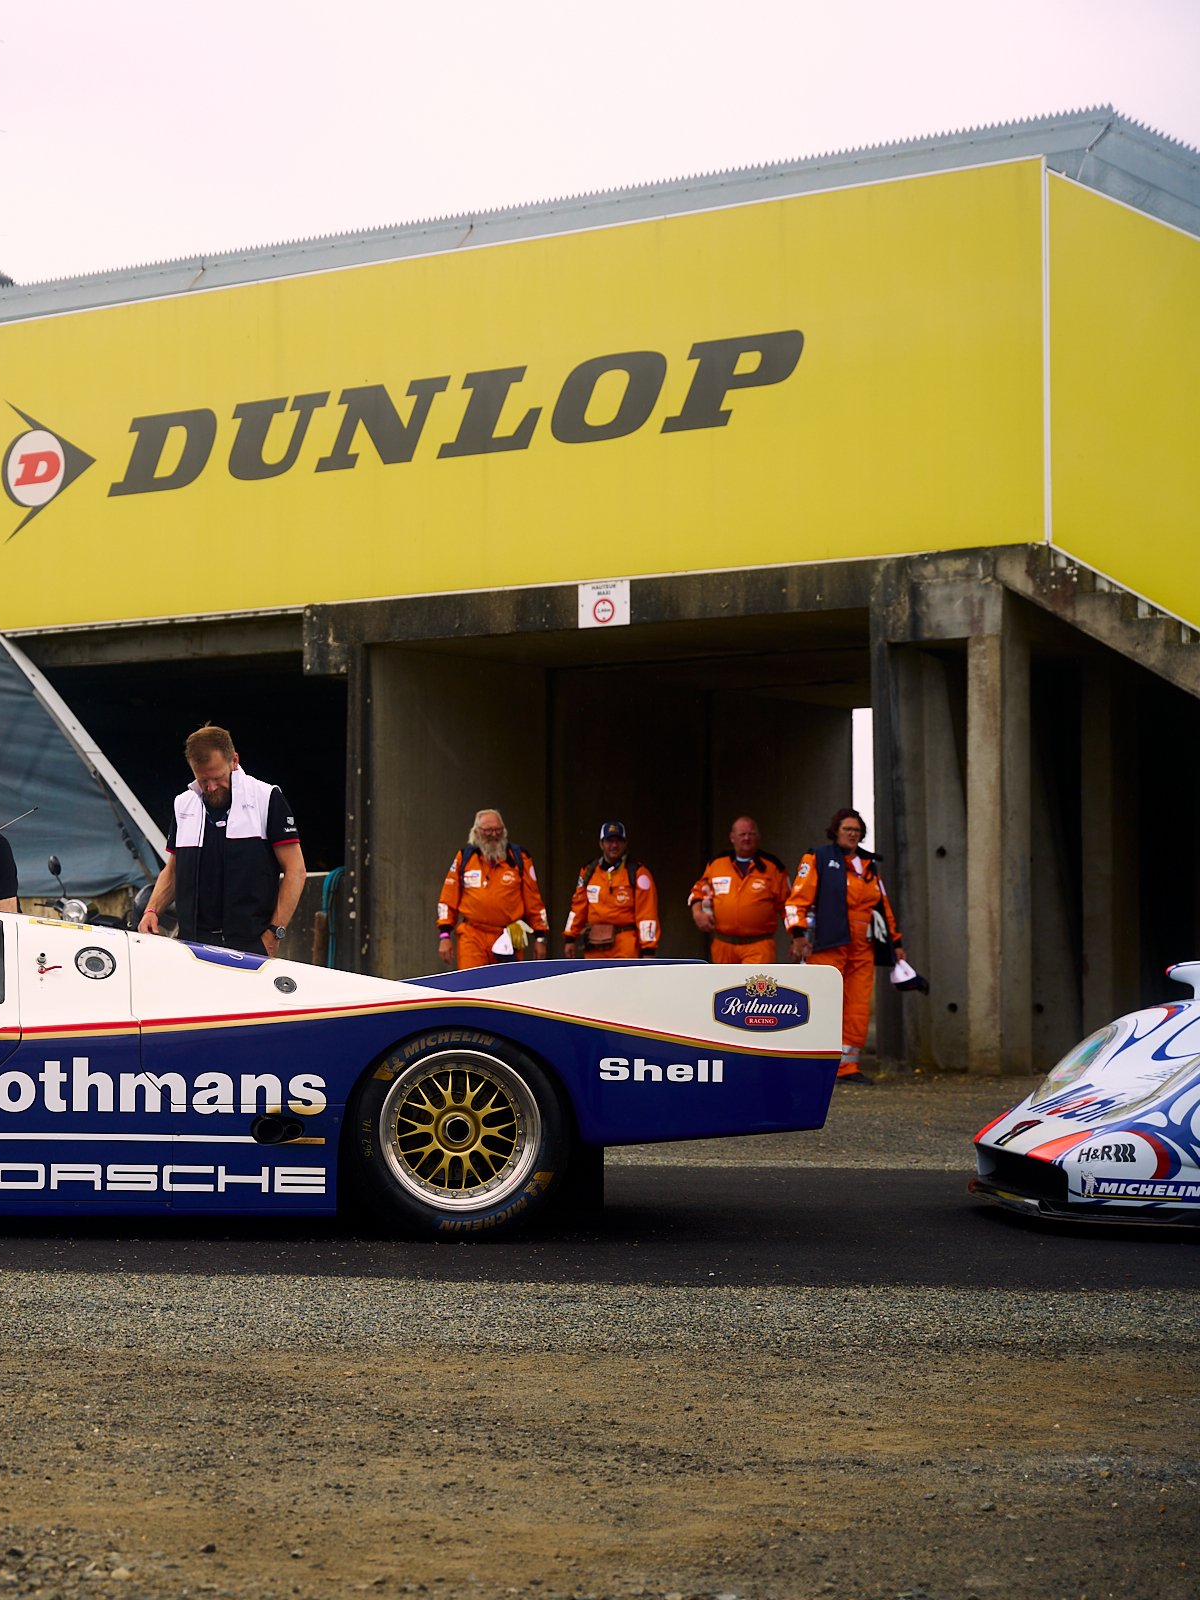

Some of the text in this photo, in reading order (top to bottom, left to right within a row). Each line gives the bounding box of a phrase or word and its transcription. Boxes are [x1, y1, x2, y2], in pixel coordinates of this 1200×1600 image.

[108, 330, 804, 497] DUNLOP
[14, 451, 61, 487] D
[721, 997, 801, 1017] Rothmans
[403, 1031, 496, 1058] MICHELIN
[599, 1057, 724, 1083] Shell
[1098, 1182, 1200, 1197] MICHELIN
[438, 1198, 528, 1232] MICHELIN
